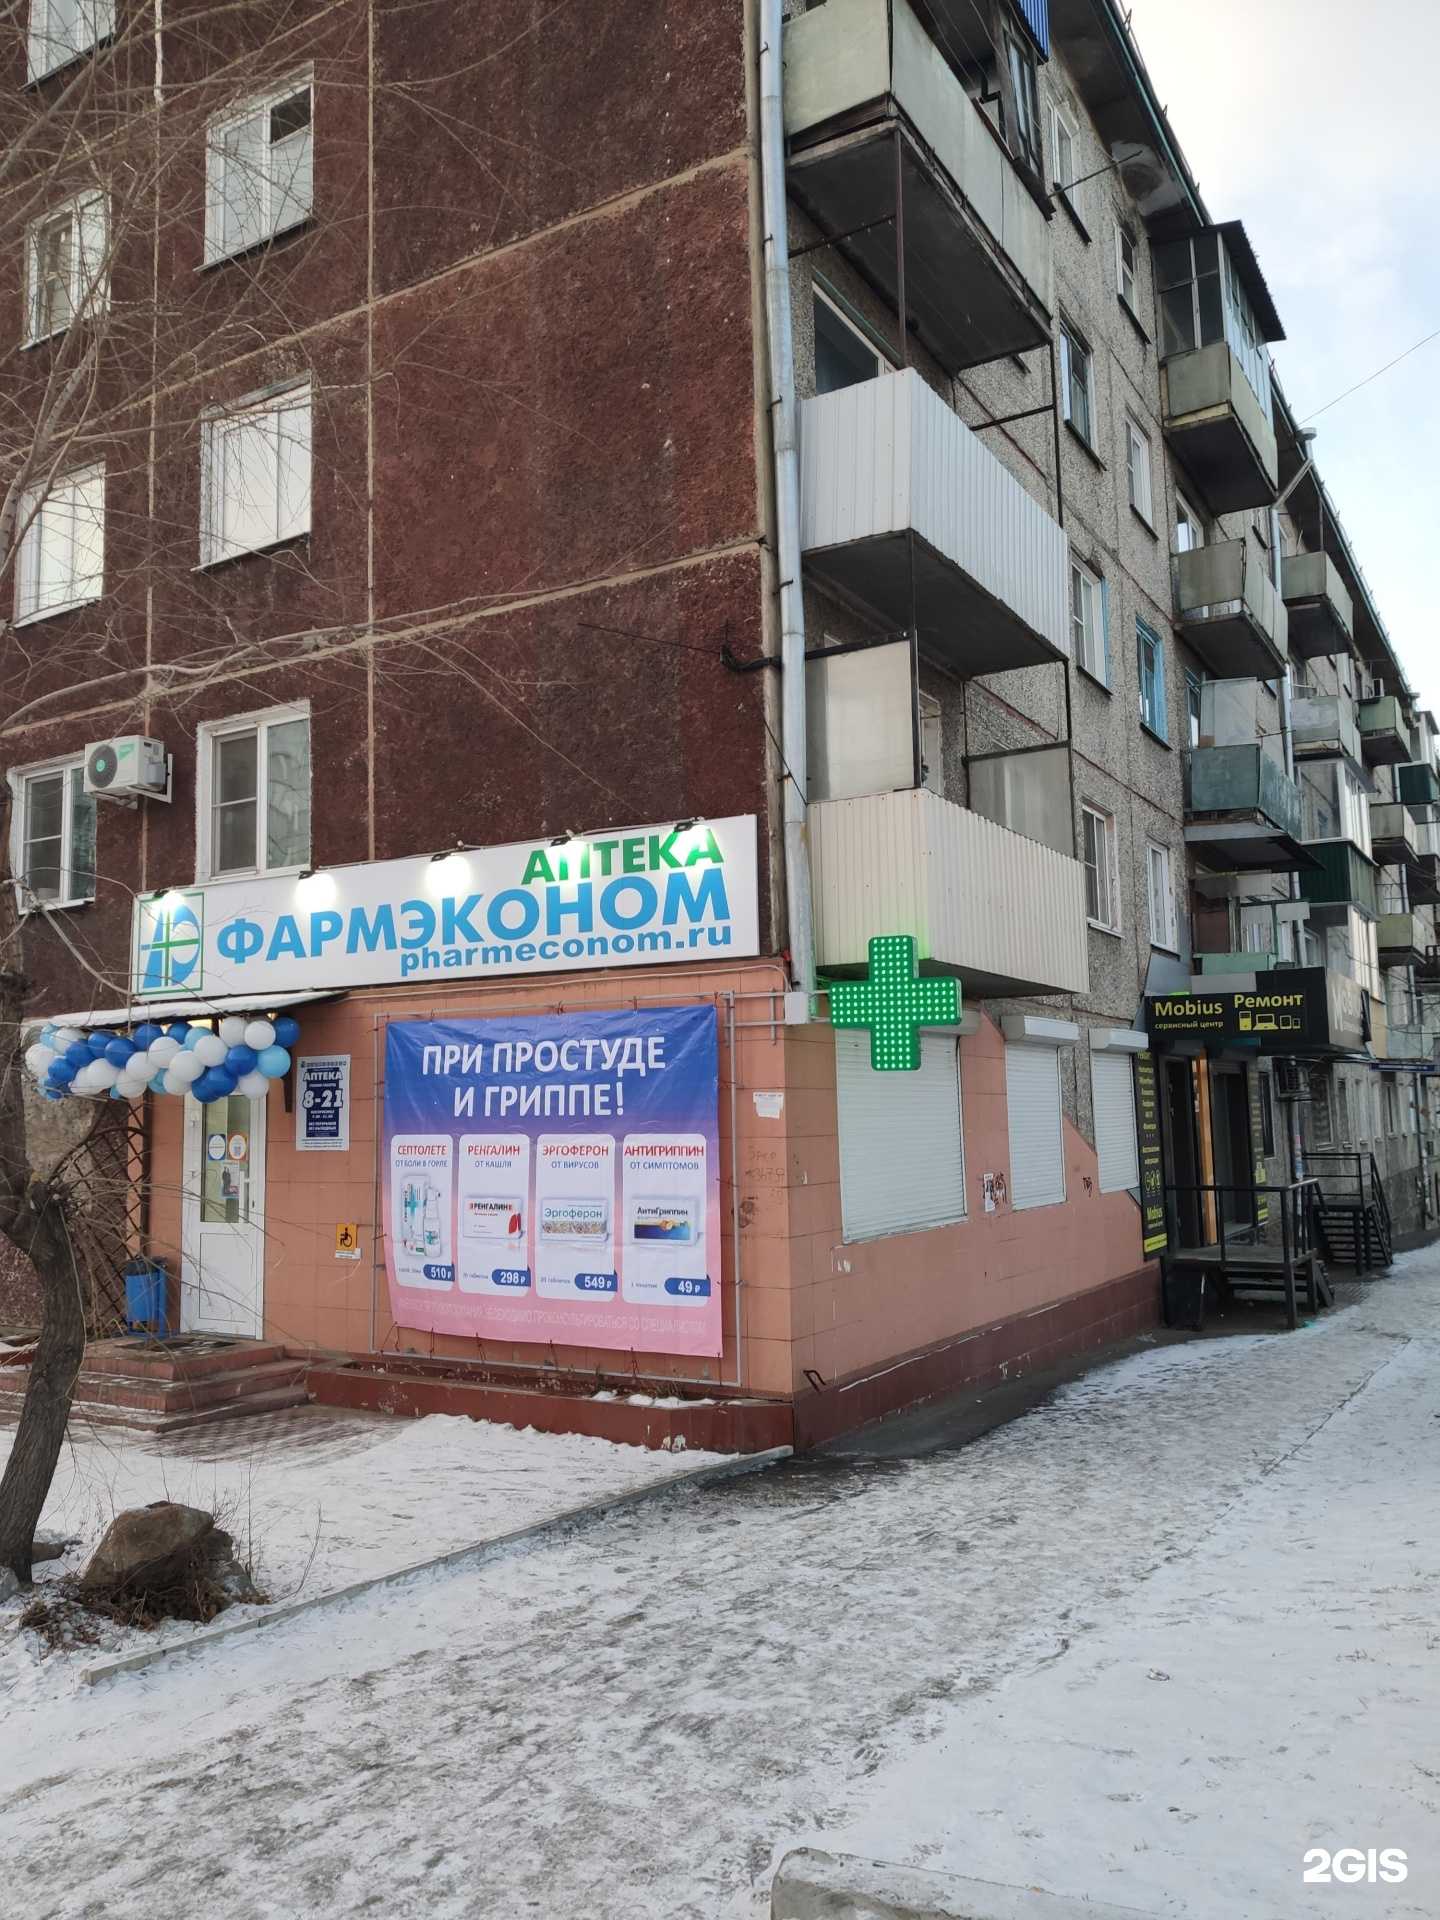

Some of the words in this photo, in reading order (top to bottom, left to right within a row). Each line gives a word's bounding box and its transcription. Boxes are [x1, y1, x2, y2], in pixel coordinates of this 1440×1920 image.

[521, 828, 724, 885] АПТЕКА
[217, 868, 730, 964] ФАРМЭКОНОМ
[401, 926, 731, 976] pharmeconom.ru
[1234, 994, 1303, 1008] Ремонт
[1155, 1000, 1223, 1016] Mobius
[1155, 1021, 1198, 1029] сервисный
[1200, 1021, 1223, 1029] центр
[423, 1044, 482, 1075] ПРИ
[492, 1037, 666, 1077] ПРОСТУДЕ
[303, 1071, 343, 1081] АПТЕКА
[302, 1089, 343, 1108] 8-21
[454, 1087, 474, 1117] И
[484, 1082, 624, 1117] ГРИППЕ!
[397, 1145, 447, 1155] СЕПТОЛЕТЕ
[468, 1145, 520, 1155] РЕНГАЛИН
[542, 1145, 609, 1156] ЭРГОФЕРОН
[624, 1146, 704, 1156] АНТИГРИППИН
[486, 1160, 512, 1168] КАШЛЯ
[563, 1161, 599, 1169] ВИРУСОВ
[643, 1161, 699, 1170] СИМПТОМОВ
[474, 1203, 507, 1211] РЕНГАЛИН
[545, 1208, 602, 1220] Эргоферон
[431, 1267, 447, 1279] 510
[500, 1272, 519, 1284] 298
[584, 1276, 605, 1288] 549
[678, 1280, 692, 1293] 49
